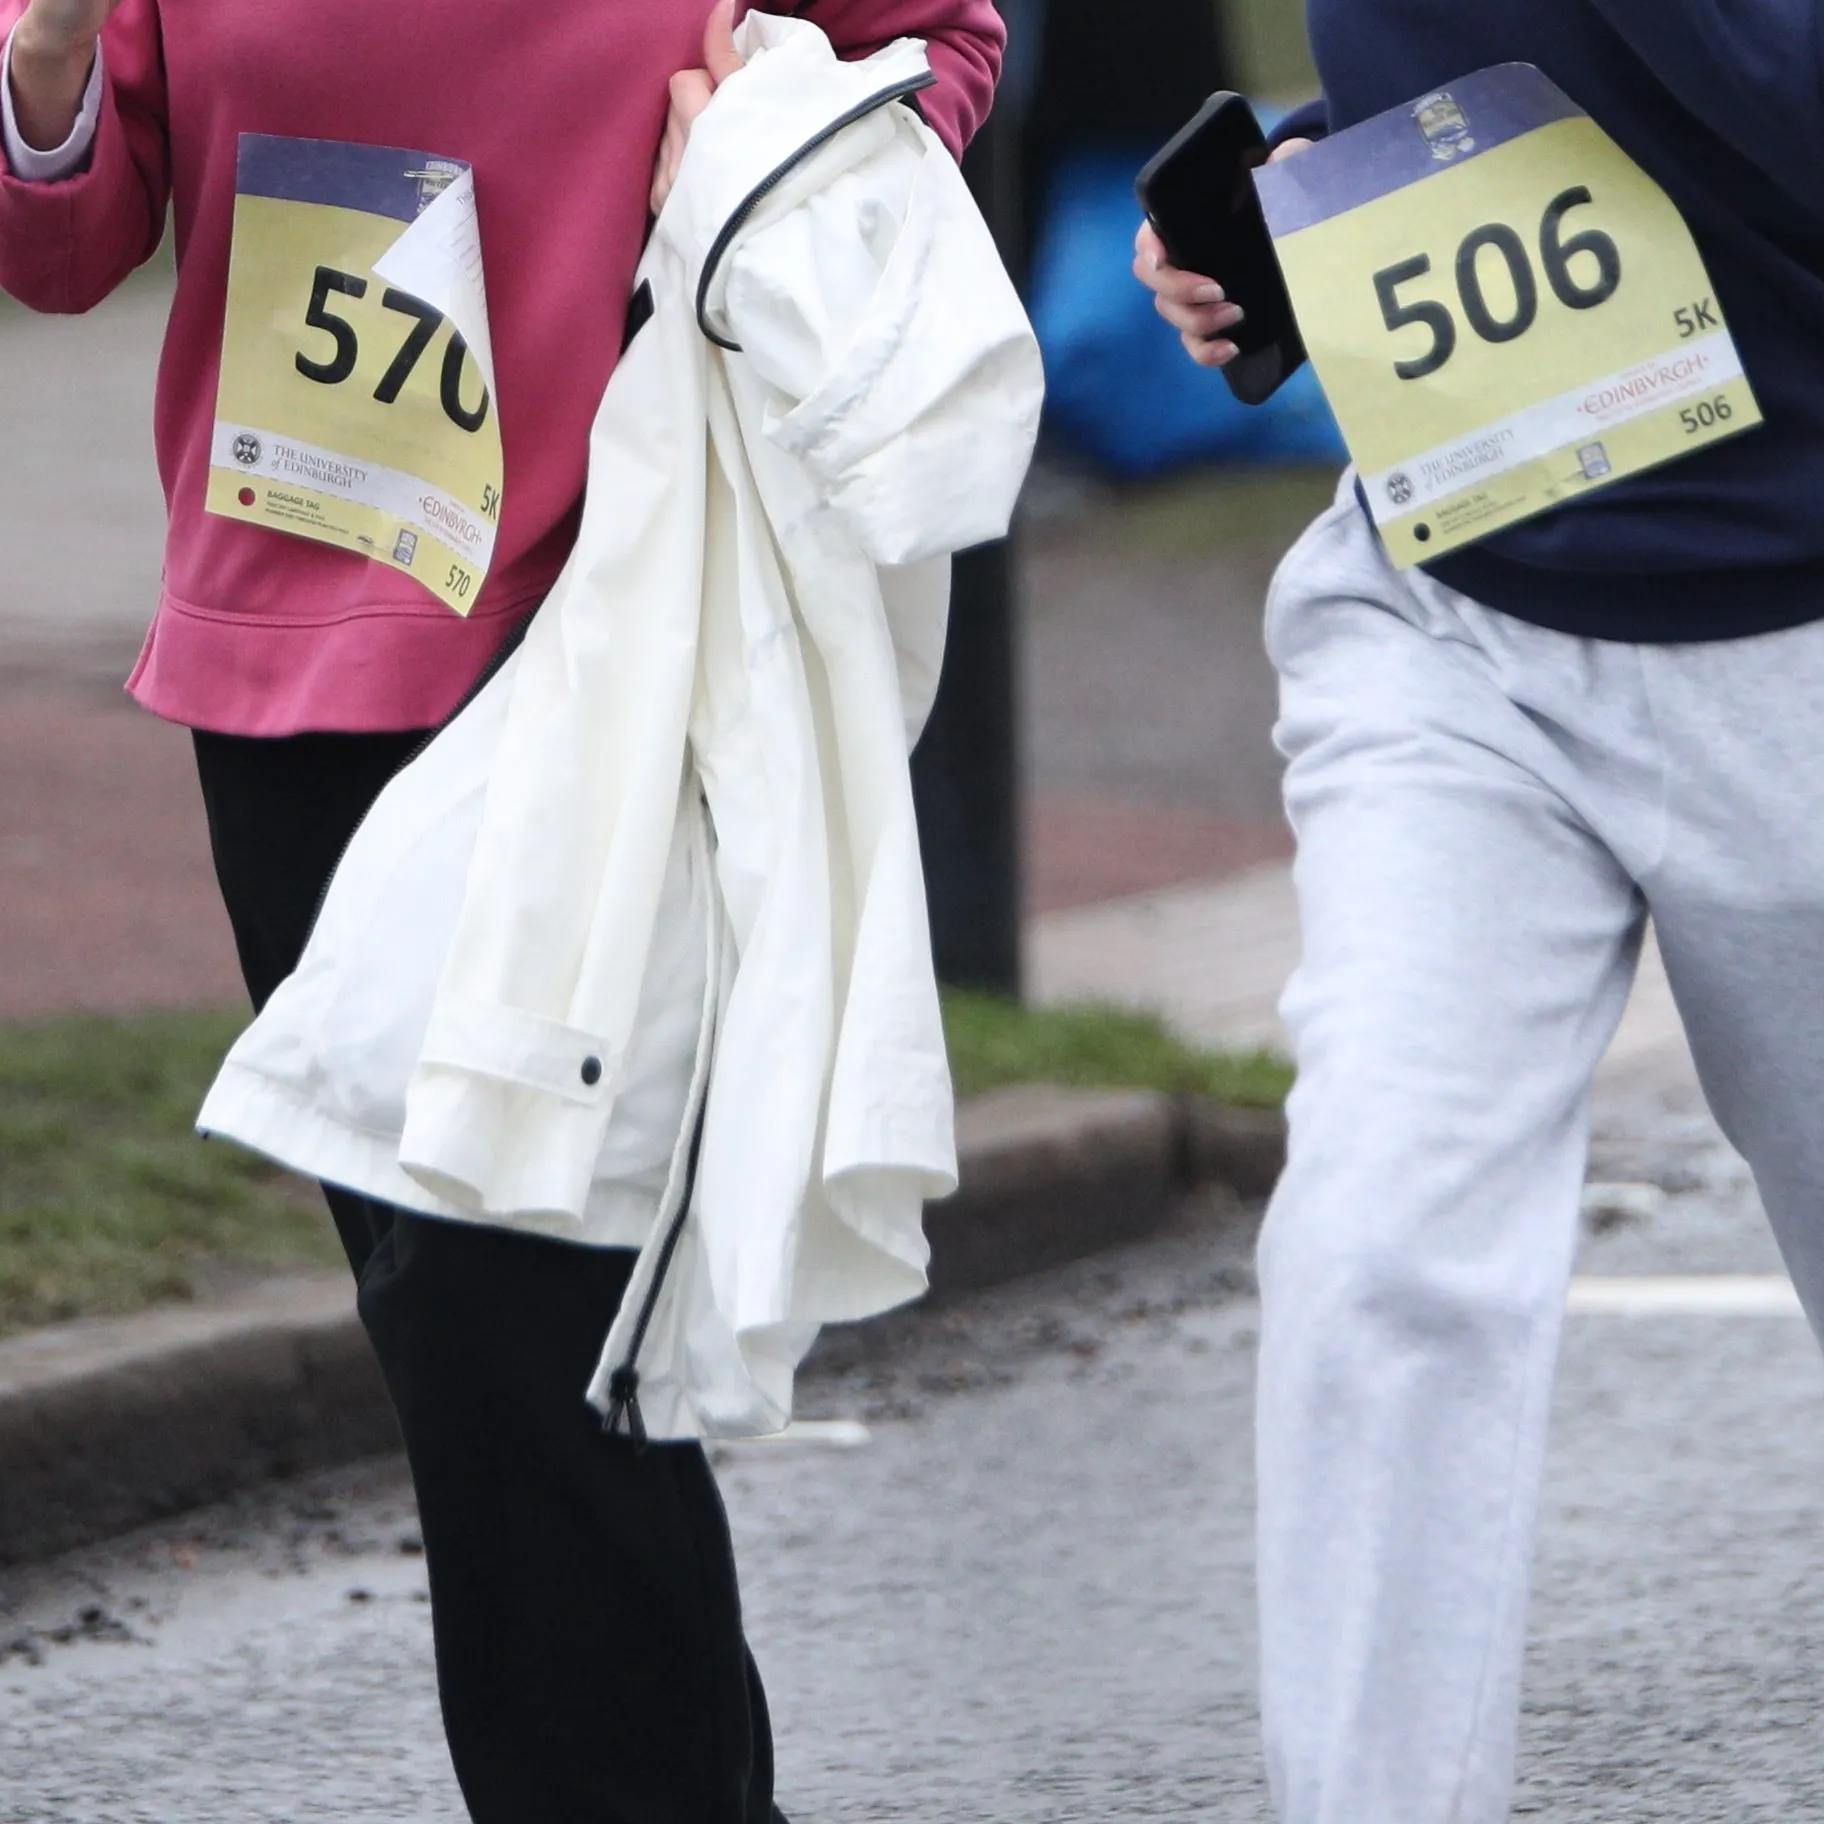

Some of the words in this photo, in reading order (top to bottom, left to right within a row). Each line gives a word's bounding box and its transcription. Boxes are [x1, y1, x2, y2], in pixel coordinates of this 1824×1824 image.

[1372, 184, 1622, 380] 506
[1673, 296, 1718, 338] 5K
[294, 265, 490, 433] 570
[1678, 394, 1733, 435] 506
[273, 443, 299, 460] THE
[300, 451, 369, 482] UNIVERSITY
[283, 460, 353, 489] EDINBURGH
[480, 482, 501, 521] 5K
[445, 563, 471, 597] 570
